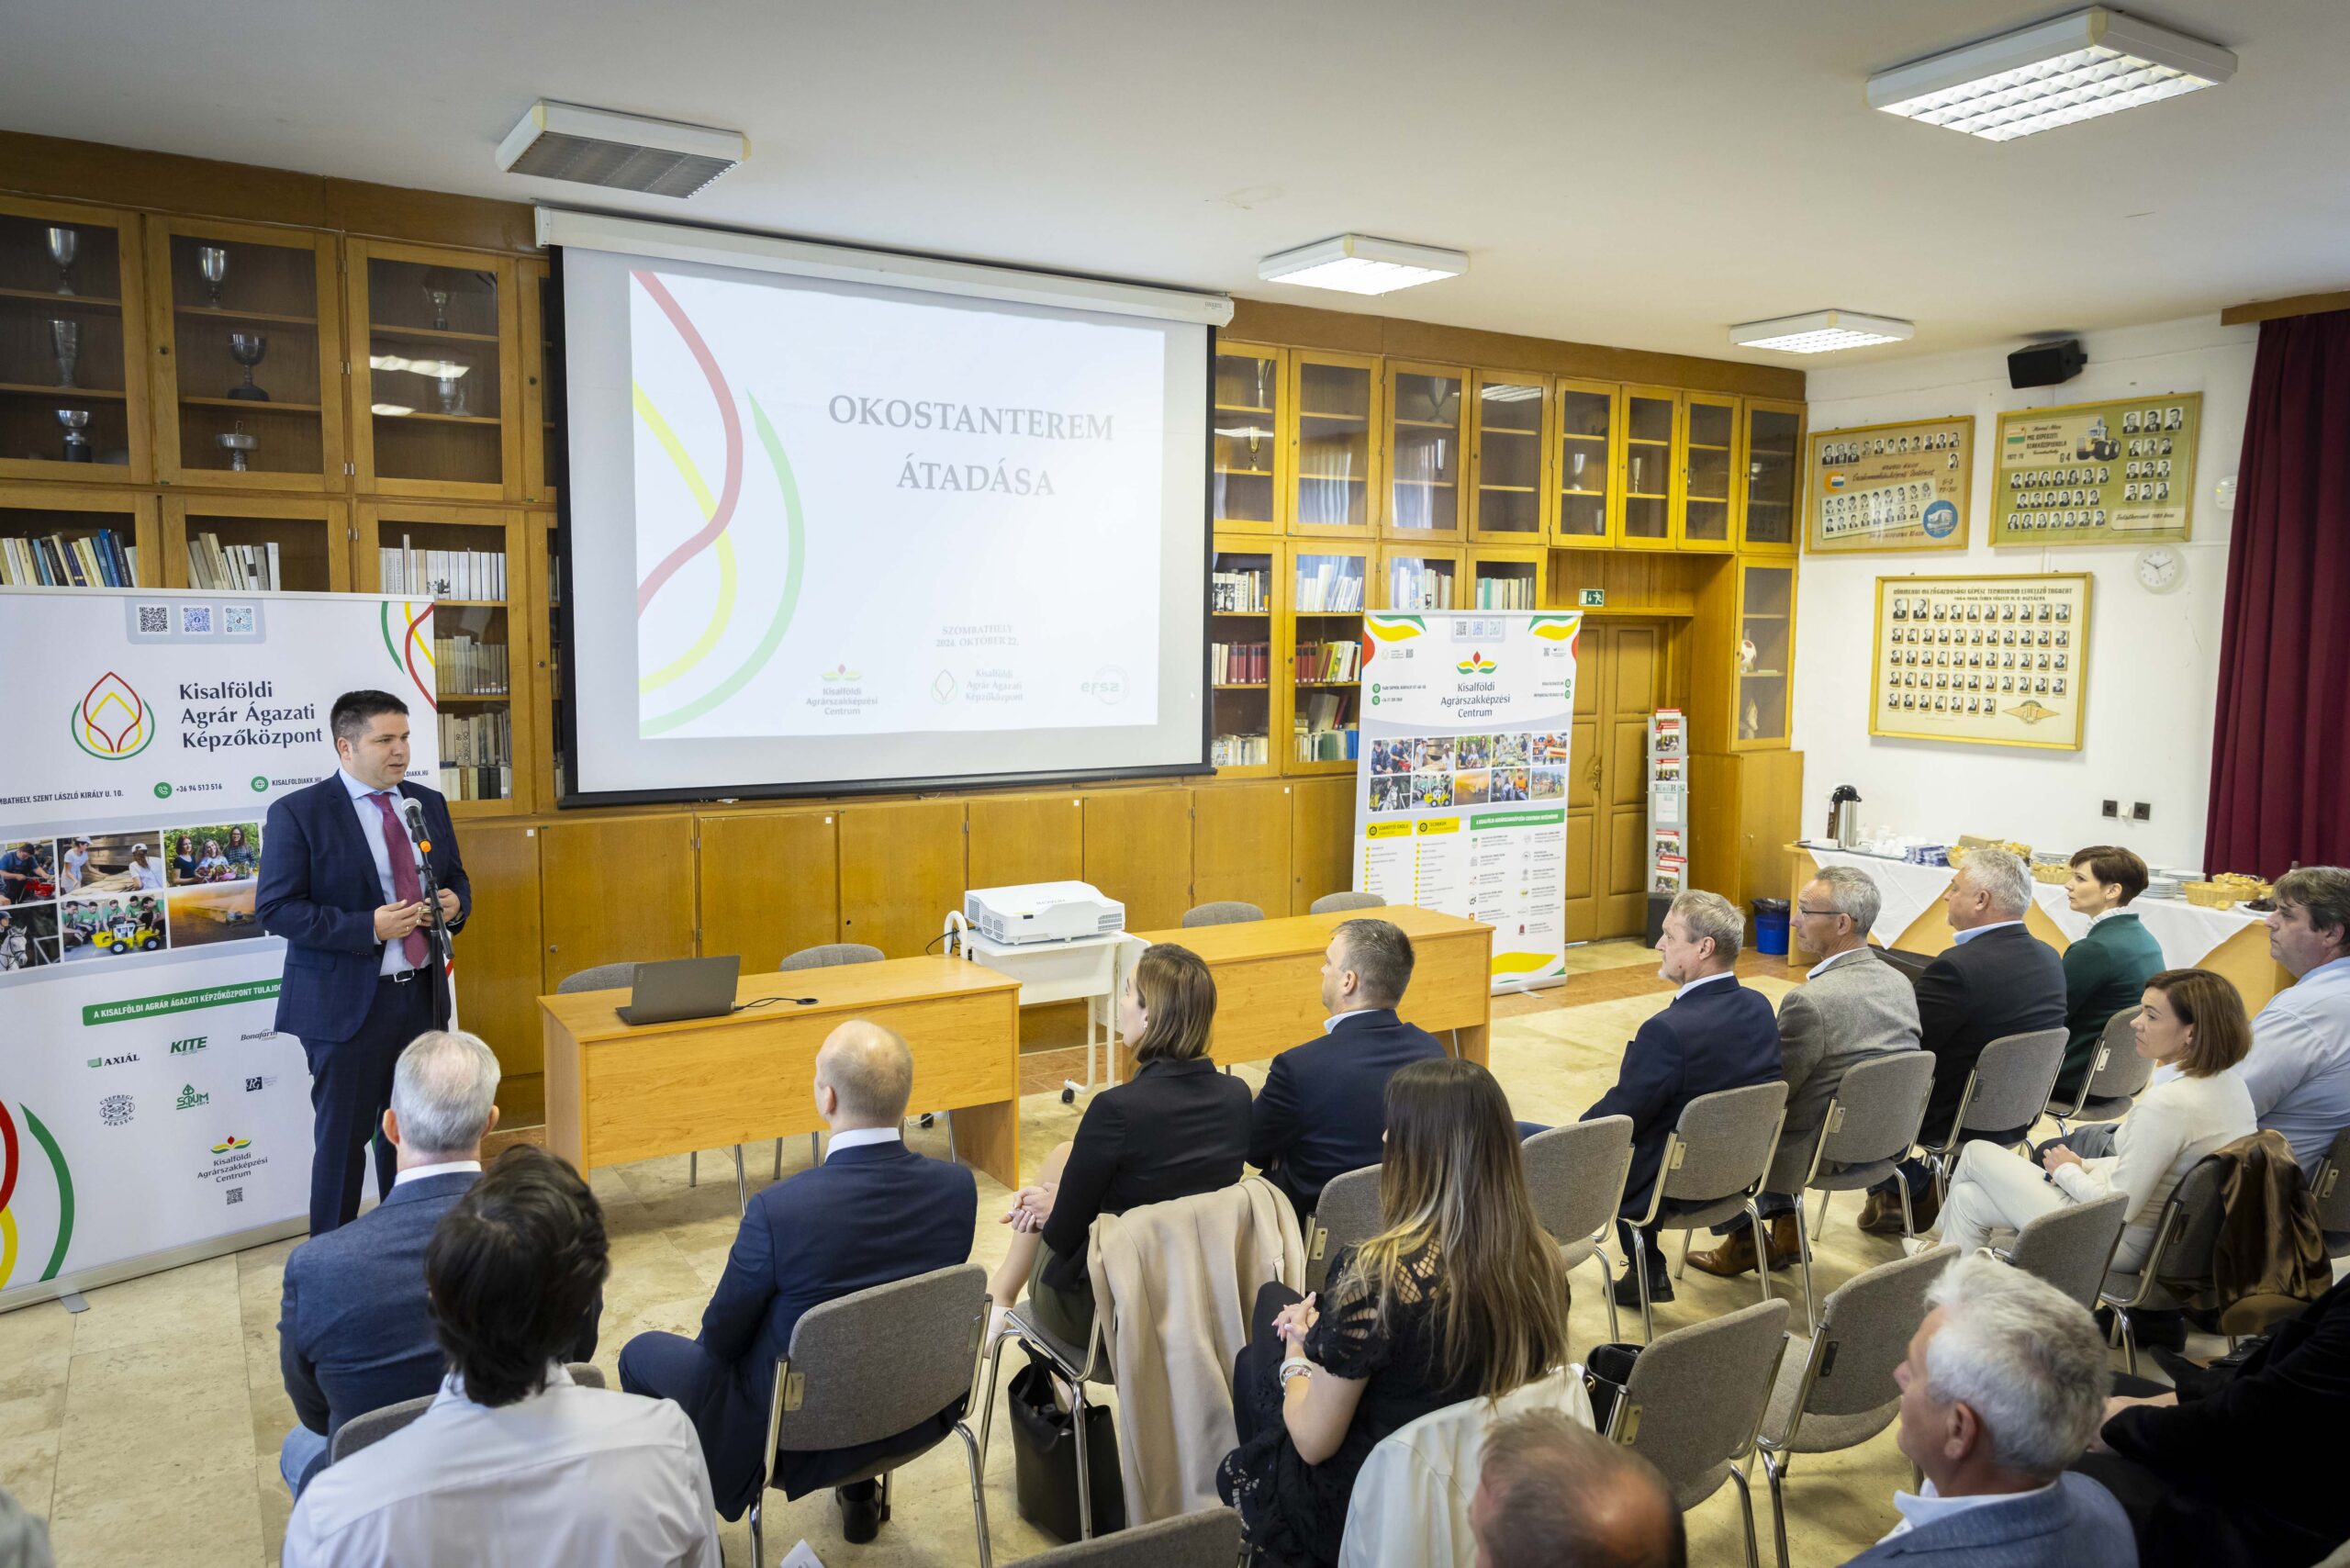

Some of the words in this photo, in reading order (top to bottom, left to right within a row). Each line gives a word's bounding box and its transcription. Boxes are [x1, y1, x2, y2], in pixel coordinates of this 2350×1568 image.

[829, 394, 1114, 442] OKOSTANTEREM
[896, 453, 1057, 497] ÁTADÁSA
[941, 624, 1013, 635] SZOMBATHELY
[179, 680, 274, 700] Kisalföldi
[822, 687, 862, 696] Kisalföldi
[1457, 681, 1495, 692] Kisalföldi
[805, 696, 878, 707] Agrárszakképzési
[1440, 694, 1511, 707] Agrárszakképzési
[181, 706, 239, 726] Agrár
[244, 701, 316, 724] Ágazati
[823, 707, 861, 716] Centrum
[1458, 708, 1493, 718] Centrum
[183, 727, 323, 753] Képzőközpont
[175, 785, 187, 793] +36
[32, 794, 53, 802] SZENT
[54, 791, 79, 801] LÁSZLÓ
[80, 790, 104, 799] KIRÁLY
[94, 1011, 100, 1019] A
[101, 1003, 144, 1018] KISALFÖLDI
[145, 1000, 169, 1011] AGRÁR
[171, 995, 199, 1007] ÁGAZATI
[199, 988, 252, 1002] KÉPZŐKÖZPONT
[170, 1036, 208, 1054] KITE
[104, 1052, 140, 1067] AXIÁL
[99, 1094, 134, 1105] CSEPREGI
[213, 1151, 252, 1167] Kisalföldi
[197, 1156, 268, 1179] Agrárszakképzési
[216, 1170, 252, 1183] Centrum
